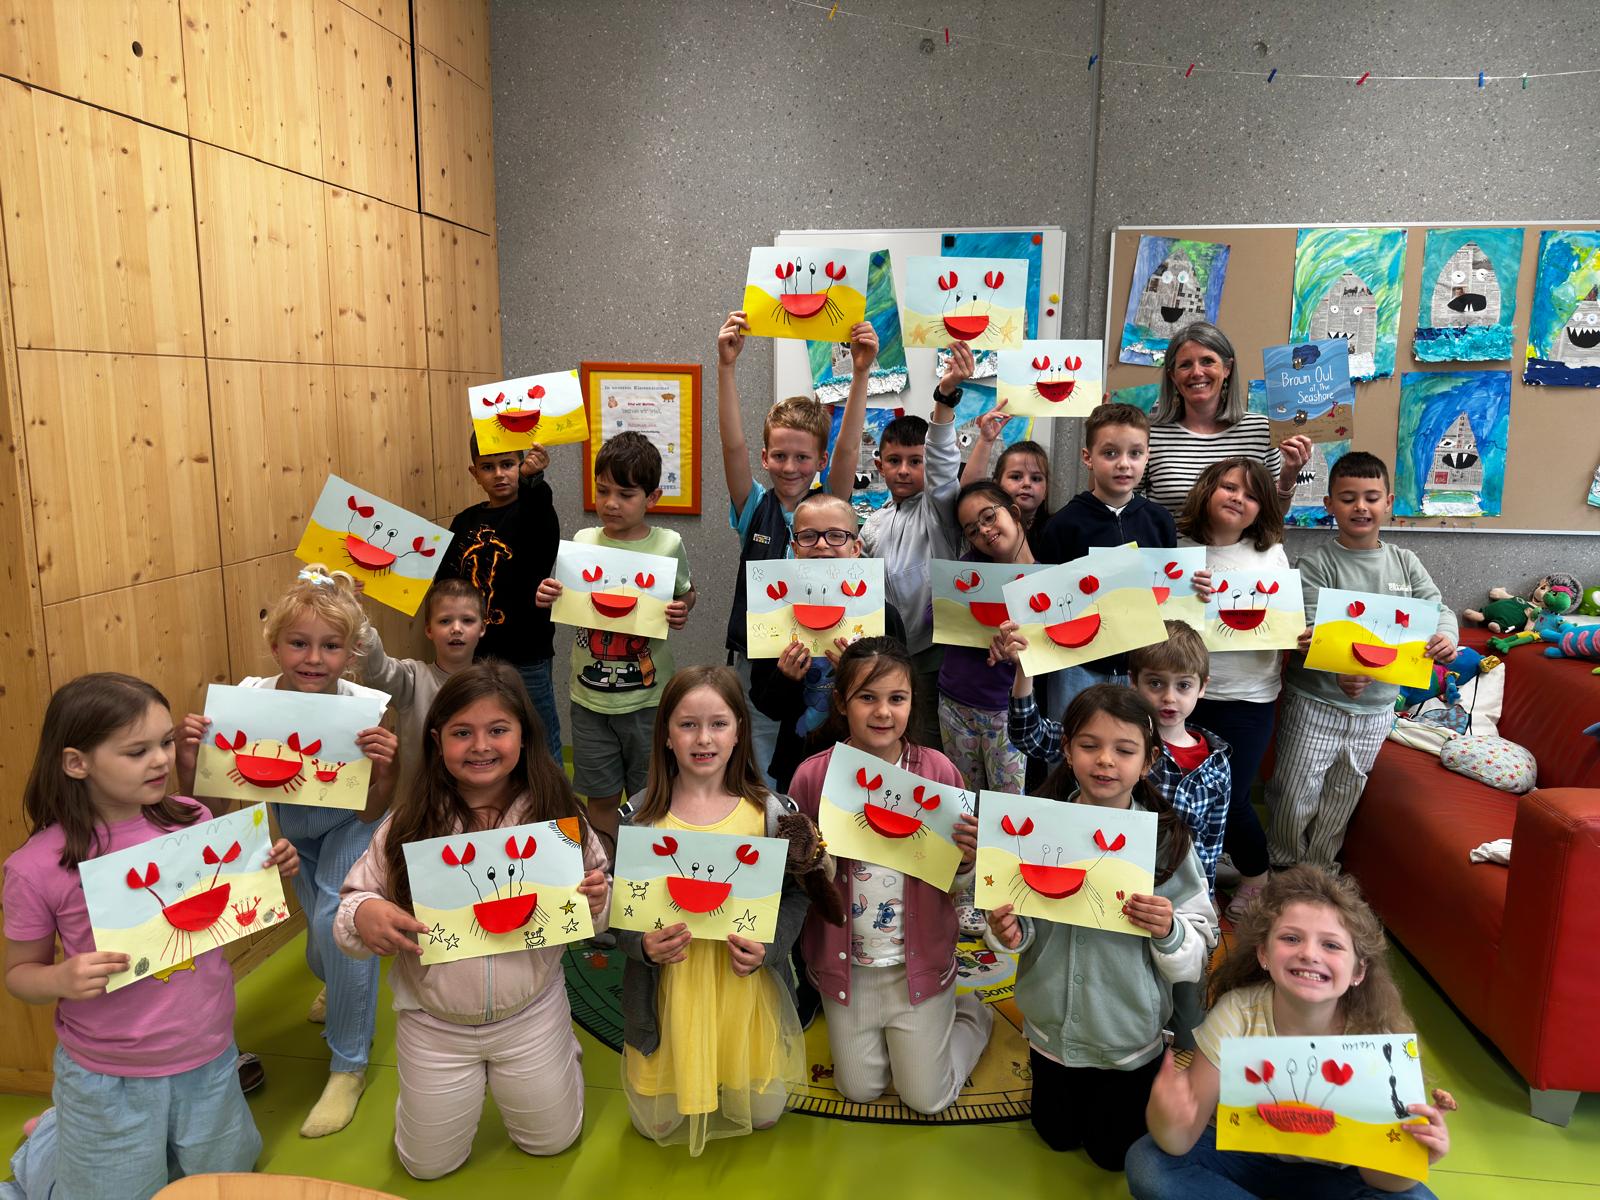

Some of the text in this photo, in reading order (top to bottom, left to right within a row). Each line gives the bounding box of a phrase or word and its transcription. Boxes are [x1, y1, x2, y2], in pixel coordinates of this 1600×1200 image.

[1281, 365, 1333, 387] Brown Owl
[1309, 384, 1316, 392] at
[1297, 390, 1334, 404] Seashore
